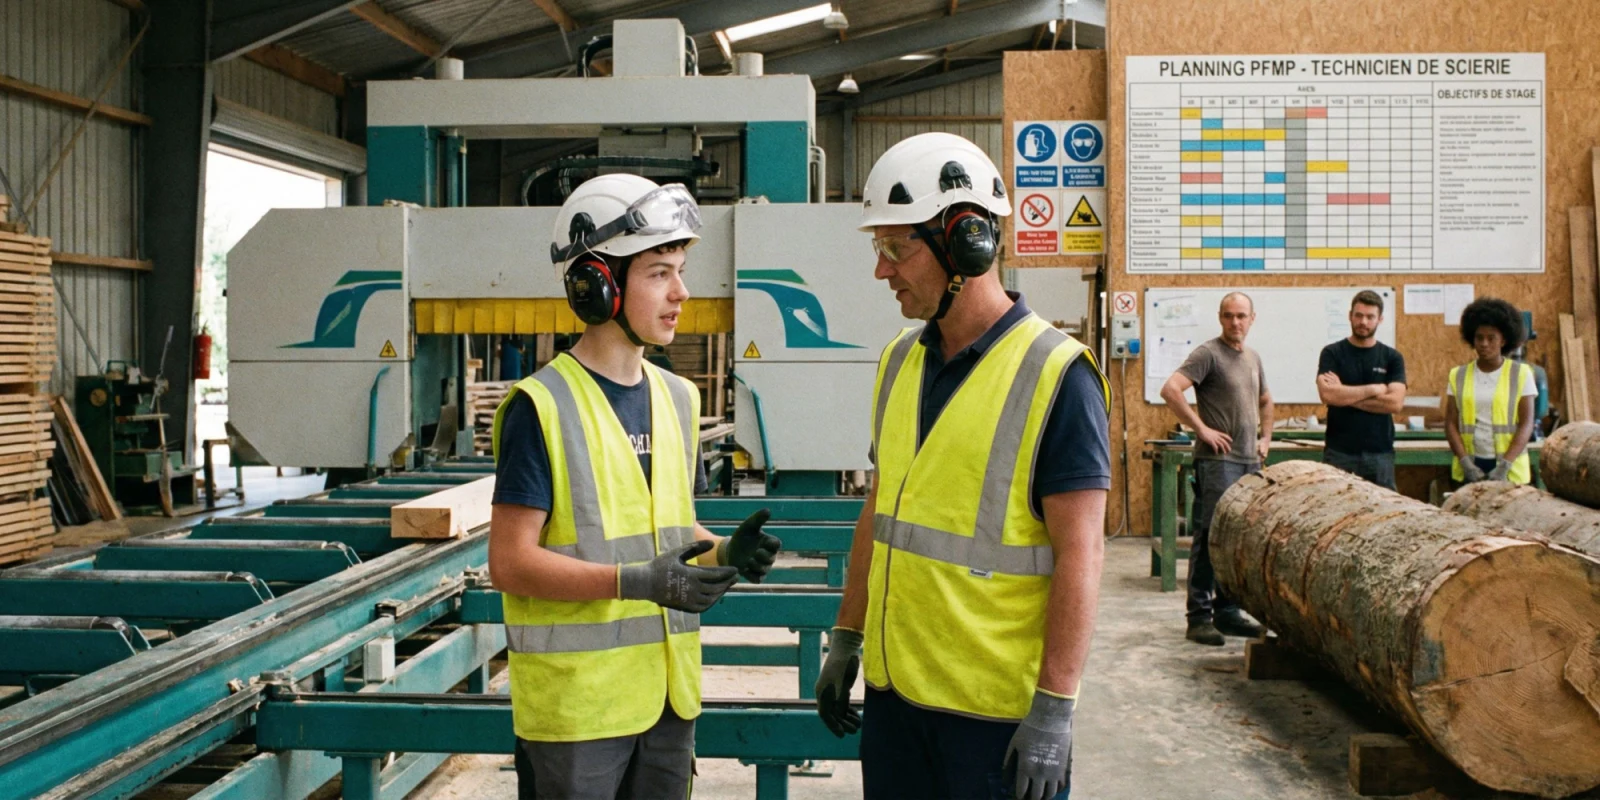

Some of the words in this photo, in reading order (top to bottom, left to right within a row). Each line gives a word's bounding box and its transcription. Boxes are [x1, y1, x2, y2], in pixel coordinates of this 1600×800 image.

[1159, 60, 1245, 77] PLANNING
[1250, 60, 1296, 76] PFMP
[1311, 59, 1412, 76] TECHNICIEN
[1417, 59, 1440, 75] DE
[1445, 58, 1511, 75] SCIERIE
[1437, 89, 1488, 99] OBJECTIFS
[1491, 89, 1503, 98] DE
[1506, 89, 1536, 98] STAGE
